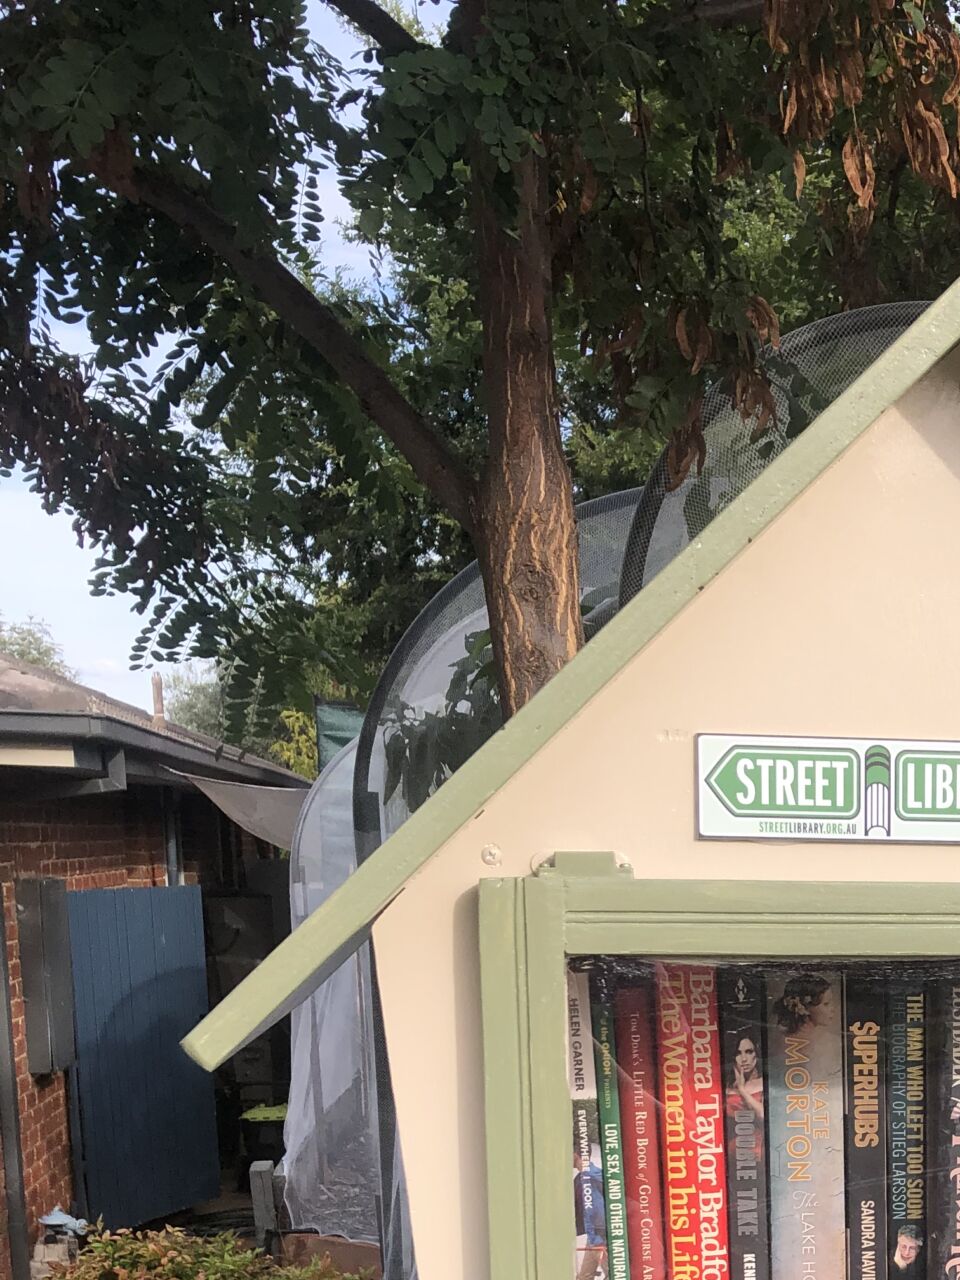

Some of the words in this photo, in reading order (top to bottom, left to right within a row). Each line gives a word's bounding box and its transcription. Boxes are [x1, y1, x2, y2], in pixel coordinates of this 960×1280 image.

[736, 758, 849, 807] STREET
[759, 822, 857, 835] STREETLIBRARY.ORG.AU
[568, 998, 581, 1038] HELEN
[658, 971, 687, 1034] The
[906, 993, 923, 1023] THE
[689, 971, 719, 1092] Barbara
[906, 1028, 923, 1060] MAN
[572, 1041, 585, 1092] GARNER
[602, 1043, 612, 1075] ONION
[892, 1024, 906, 1095] BIOGRAPHY
[631, 1071, 646, 1108] LITTLE
[661, 1033, 689, 1144] Women
[906, 1065, 923, 1100] WHO
[635, 1111, 648, 1139] RED
[784, 1036, 813, 1182] MORTON
[812, 1081, 830, 1140] KATE
[892, 1101, 906, 1119] OF
[906, 1104, 923, 1141] LEFT
[577, 1109, 591, 1173] EVERYWHERE
[604, 1123, 618, 1153] LOVE,
[636, 1138, 650, 1170] BOOK
[689, 1093, 724, 1186] Taylor
[734, 1111, 757, 1181] DOUBLE
[892, 1122, 906, 1158] STIEG
[606, 1154, 621, 1176] SEX,
[667, 1147, 694, 1181] in
[906, 1145, 923, 1176] TOO
[583, 1182, 593, 1209] LOOK
[607, 1178, 622, 1200] AND
[638, 1184, 652, 1214] GOLF
[668, 1184, 697, 1231] his
[792, 1190, 821, 1211] The
[892, 1161, 906, 1220] LARSSON
[906, 1179, 923, 1220] SOON
[609, 1203, 623, 1238] OTHER
[737, 1187, 759, 1237] TAKE
[860, 1200, 876, 1248] SANDRA
[640, 1217, 654, 1262] COURSE
[800, 1211, 816, 1256] LAKE
